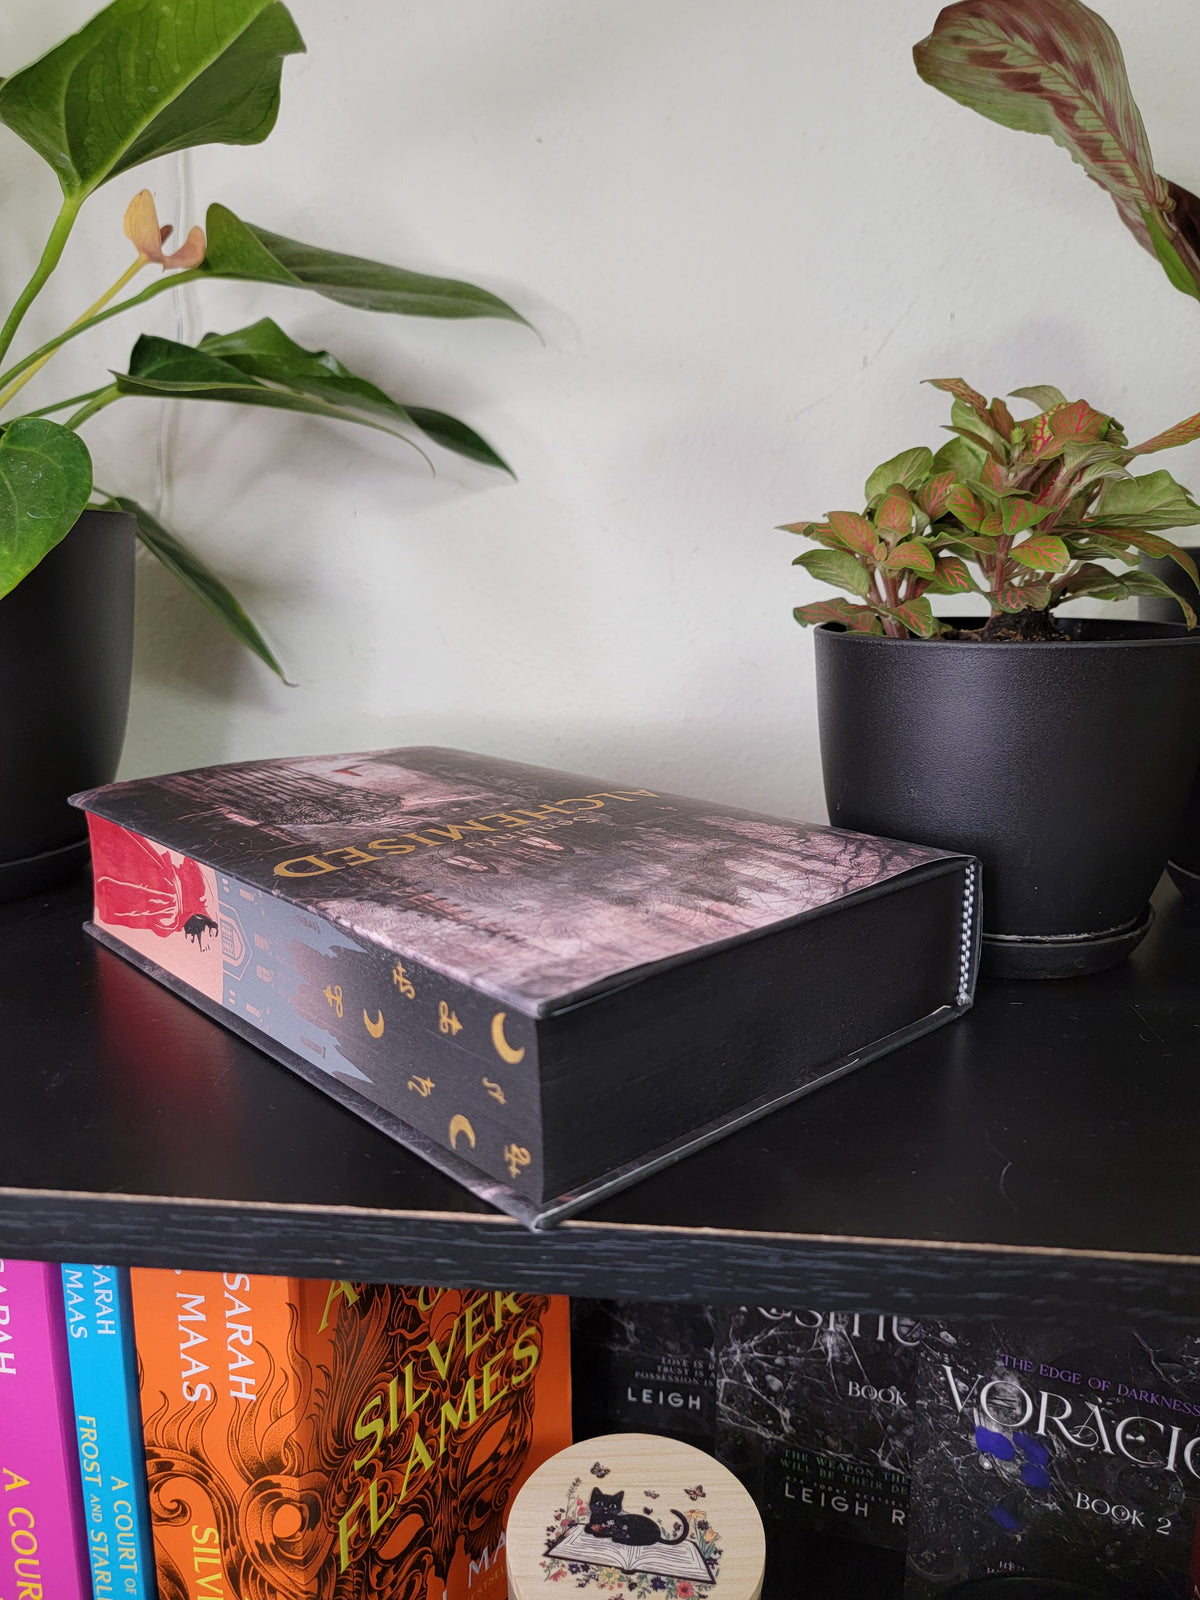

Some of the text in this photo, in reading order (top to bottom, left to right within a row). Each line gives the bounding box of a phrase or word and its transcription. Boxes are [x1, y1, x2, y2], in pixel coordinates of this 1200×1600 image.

[273, 789, 660, 878] ALCHEMISED
[65, 1269, 88, 1338] MAAS
[223, 1272, 257, 1401] SARAH
[176, 1292, 212, 1402] MAAS
[627, 1386, 701, 1411] LEIGH
[848, 1380, 908, 1407] BOOK
[1001, 1353, 1200, 1417] THE EDGE OF DARKNESS
[77, 1413, 103, 1488] FROST
[90, 1493, 103, 1523] AND
[337, 1326, 540, 1574] FLAMES
[816, 1456, 875, 1479] WEAPON
[883, 1471, 909, 1485] THE
[784, 1481, 907, 1526] LEIGH R
[891, 1483, 909, 1496] DE
[1076, 1492, 1173, 1536] BOOK 2
[3, 1467, 43, 1600] A COUR
[111, 1475, 138, 1595] A COURT OF
[468, 1531, 506, 1588] MA
